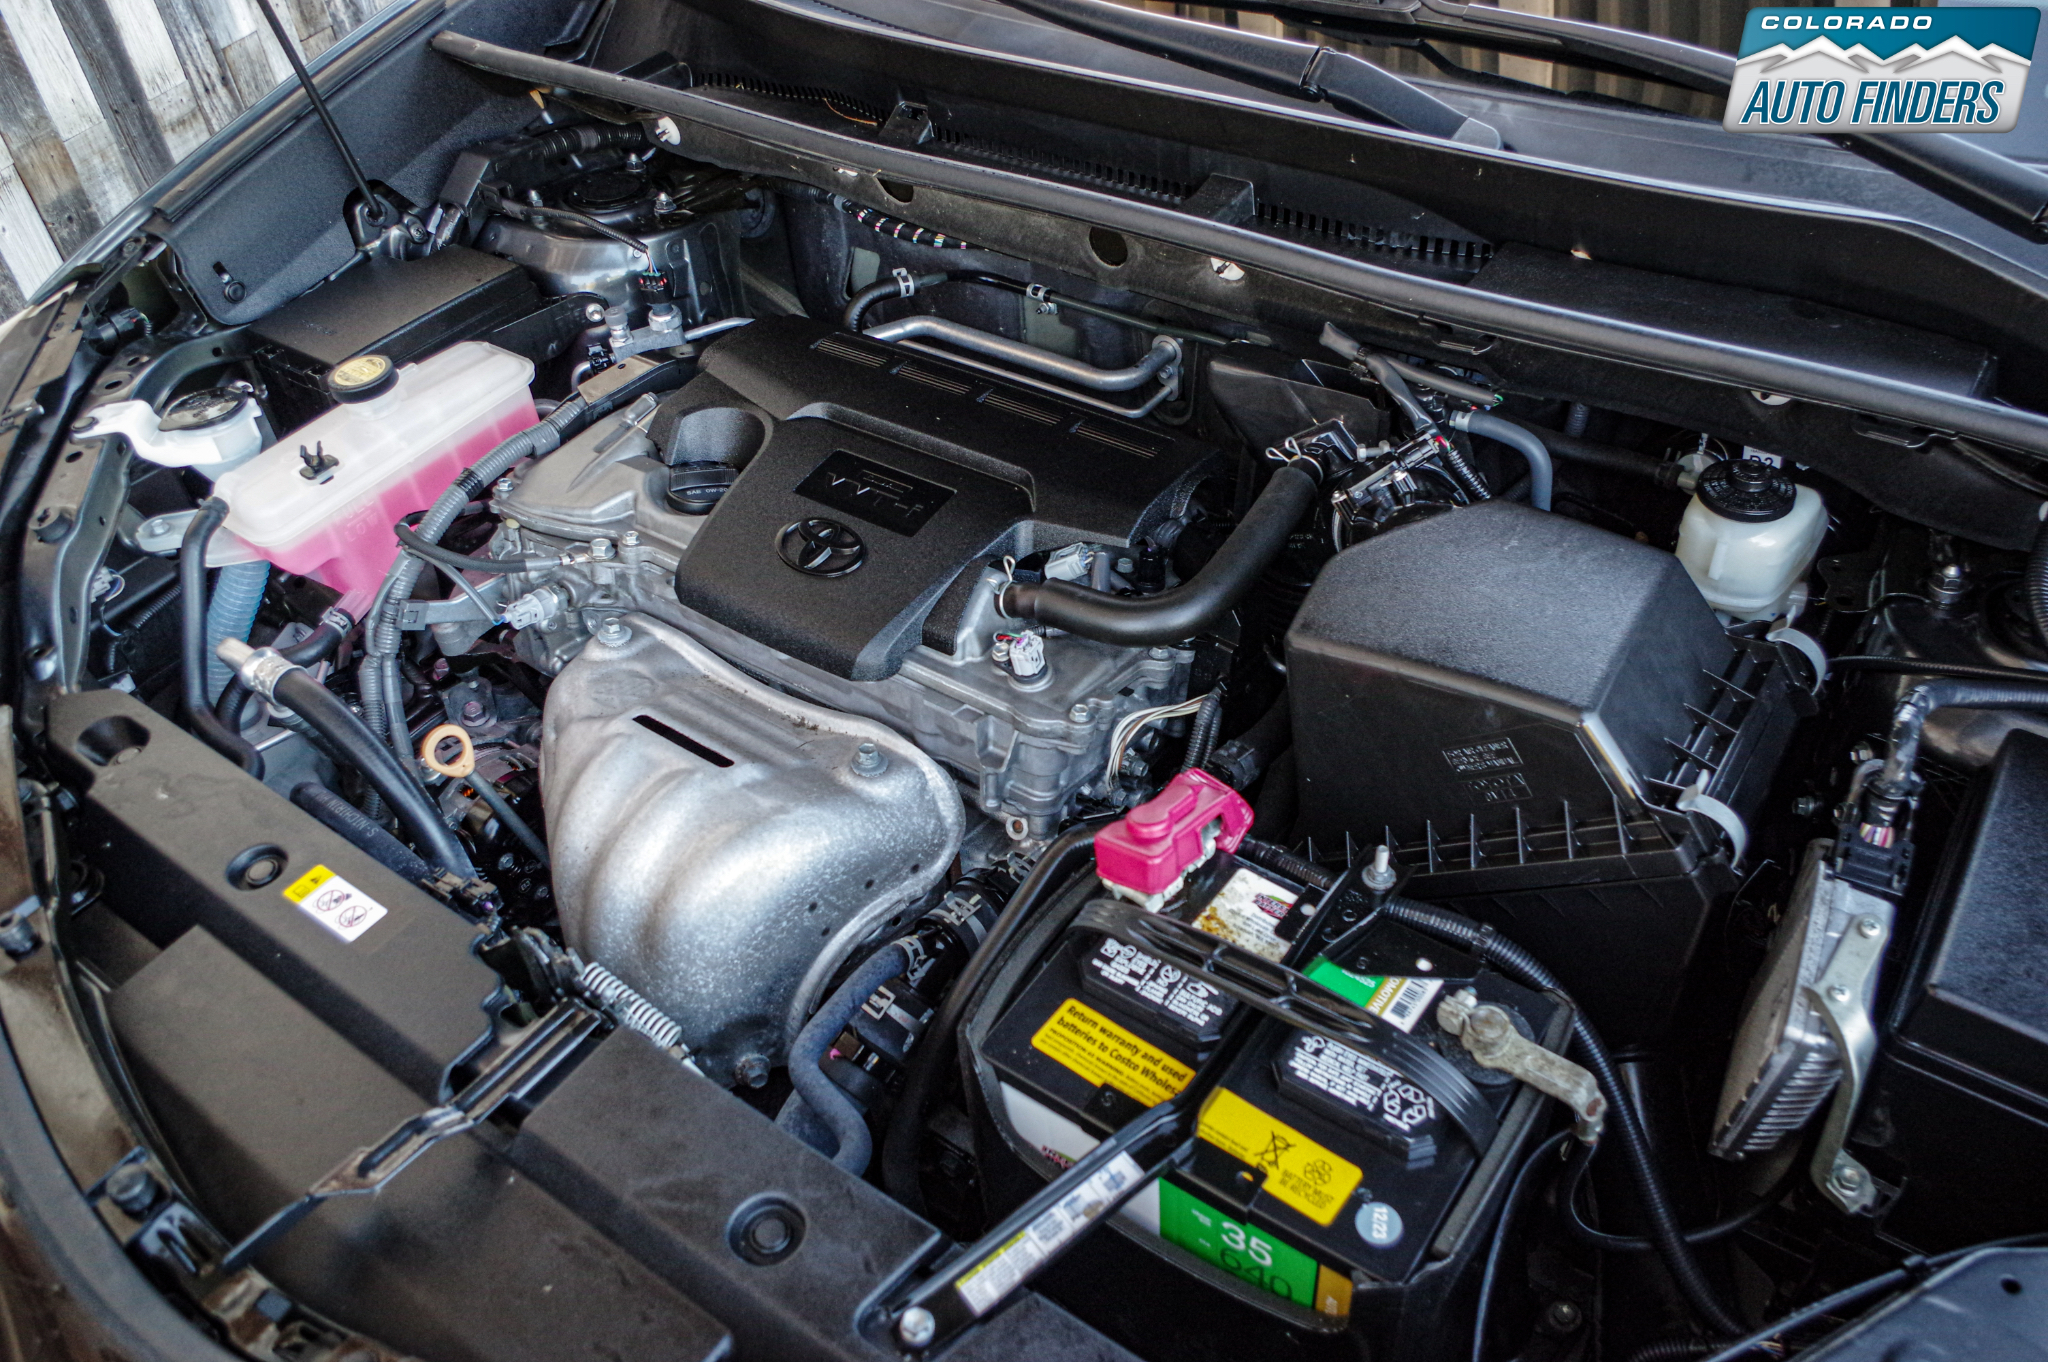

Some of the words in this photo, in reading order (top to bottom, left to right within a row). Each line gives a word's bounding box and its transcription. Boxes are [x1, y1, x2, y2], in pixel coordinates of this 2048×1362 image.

[1254, 898, 1284, 917] BATTER
[1257, 892, 1288, 913] INTERST
[1367, 978, 1402, 1016] OMOTIVE
[1056, 1016, 1097, 1047] batteries
[1098, 1039, 1109, 1053] to
[1110, 1048, 1140, 1072] Costco
[1141, 1066, 1179, 1095] Wholes
[1067, 1005, 1098, 1029] Return
[1099, 1024, 1140, 1056] warranty
[1141, 1048, 1163, 1067] and
[1161, 1063, 1188, 1082] used
[1221, 1221, 1274, 1267] 35
[1371, 1206, 1389, 1240] 12/23
[1219, 1248, 1293, 1300] 640
